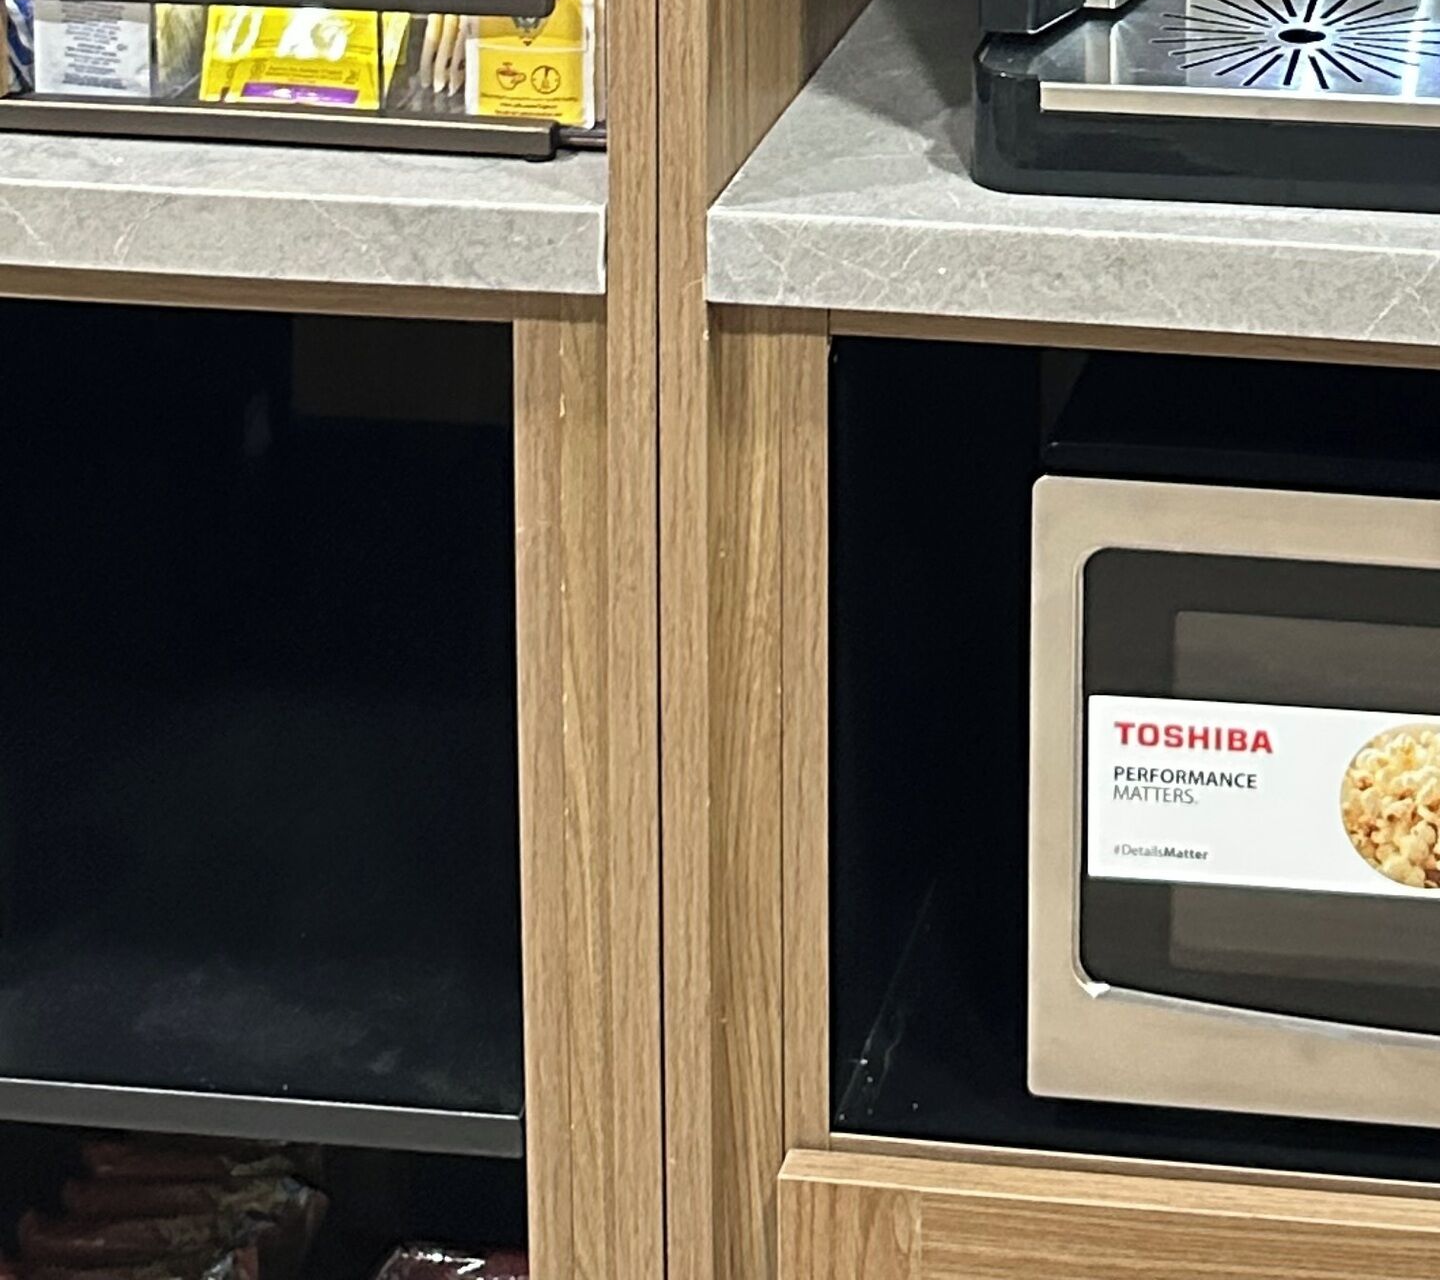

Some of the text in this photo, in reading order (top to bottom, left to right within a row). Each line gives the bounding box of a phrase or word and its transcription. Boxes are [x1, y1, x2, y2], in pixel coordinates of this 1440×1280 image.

[1114, 721, 1273, 754] TOSHIBA
[1114, 766, 1258, 790] PERFORMANCE
[1114, 843, 1208, 861] #DetailsMatter
